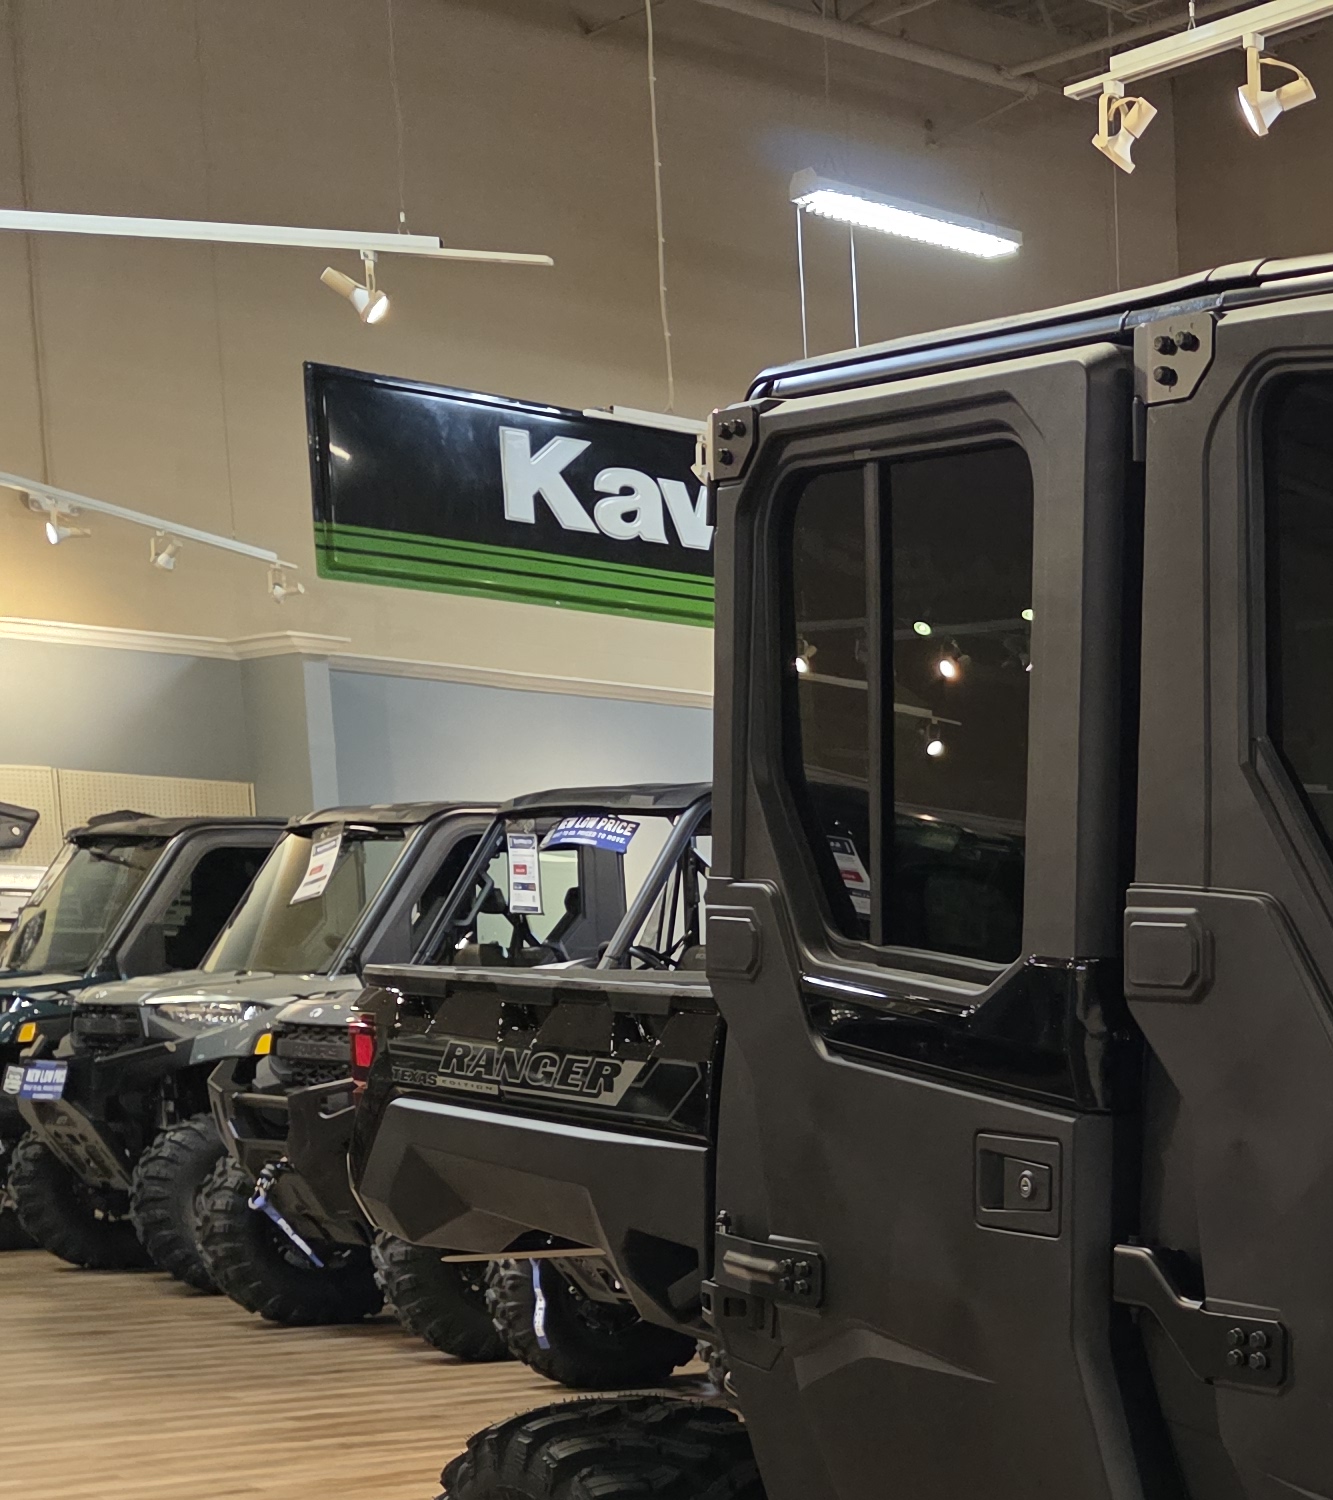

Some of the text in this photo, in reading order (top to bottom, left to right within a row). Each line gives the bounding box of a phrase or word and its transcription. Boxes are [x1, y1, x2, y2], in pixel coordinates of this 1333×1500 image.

[596, 817, 637, 836] PRICE
[392, 1066, 494, 1092] TEXAS EDITION
[438, 1041, 625, 1098] RANGER
